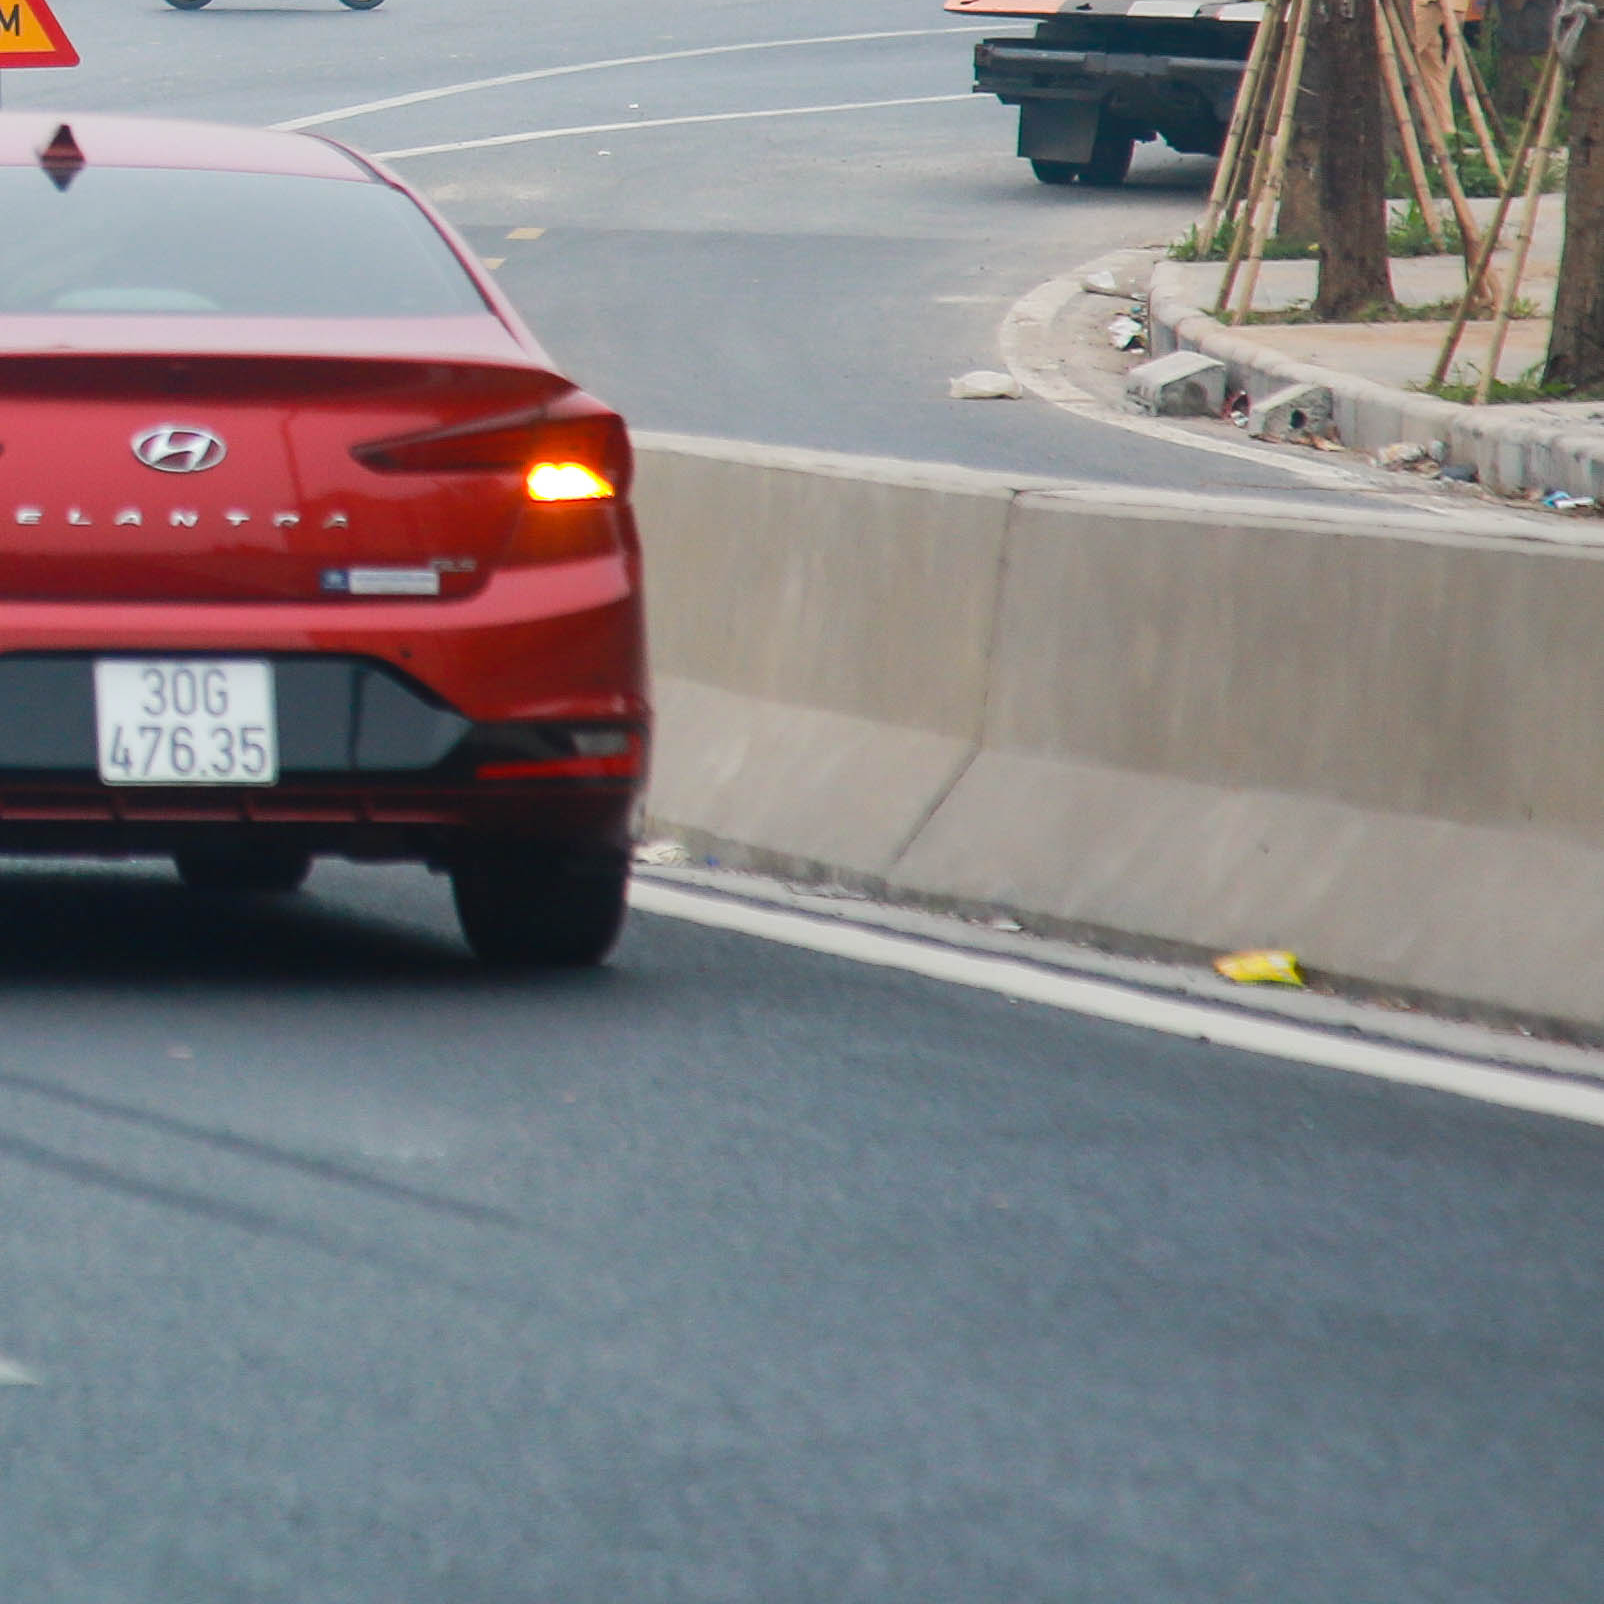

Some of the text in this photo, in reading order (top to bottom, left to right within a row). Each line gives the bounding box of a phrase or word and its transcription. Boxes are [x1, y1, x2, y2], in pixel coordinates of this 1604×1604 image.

[15, 508, 349, 529] ELANTRA
[141, 666, 230, 716] 30G
[108, 725, 268, 779] 476.35
